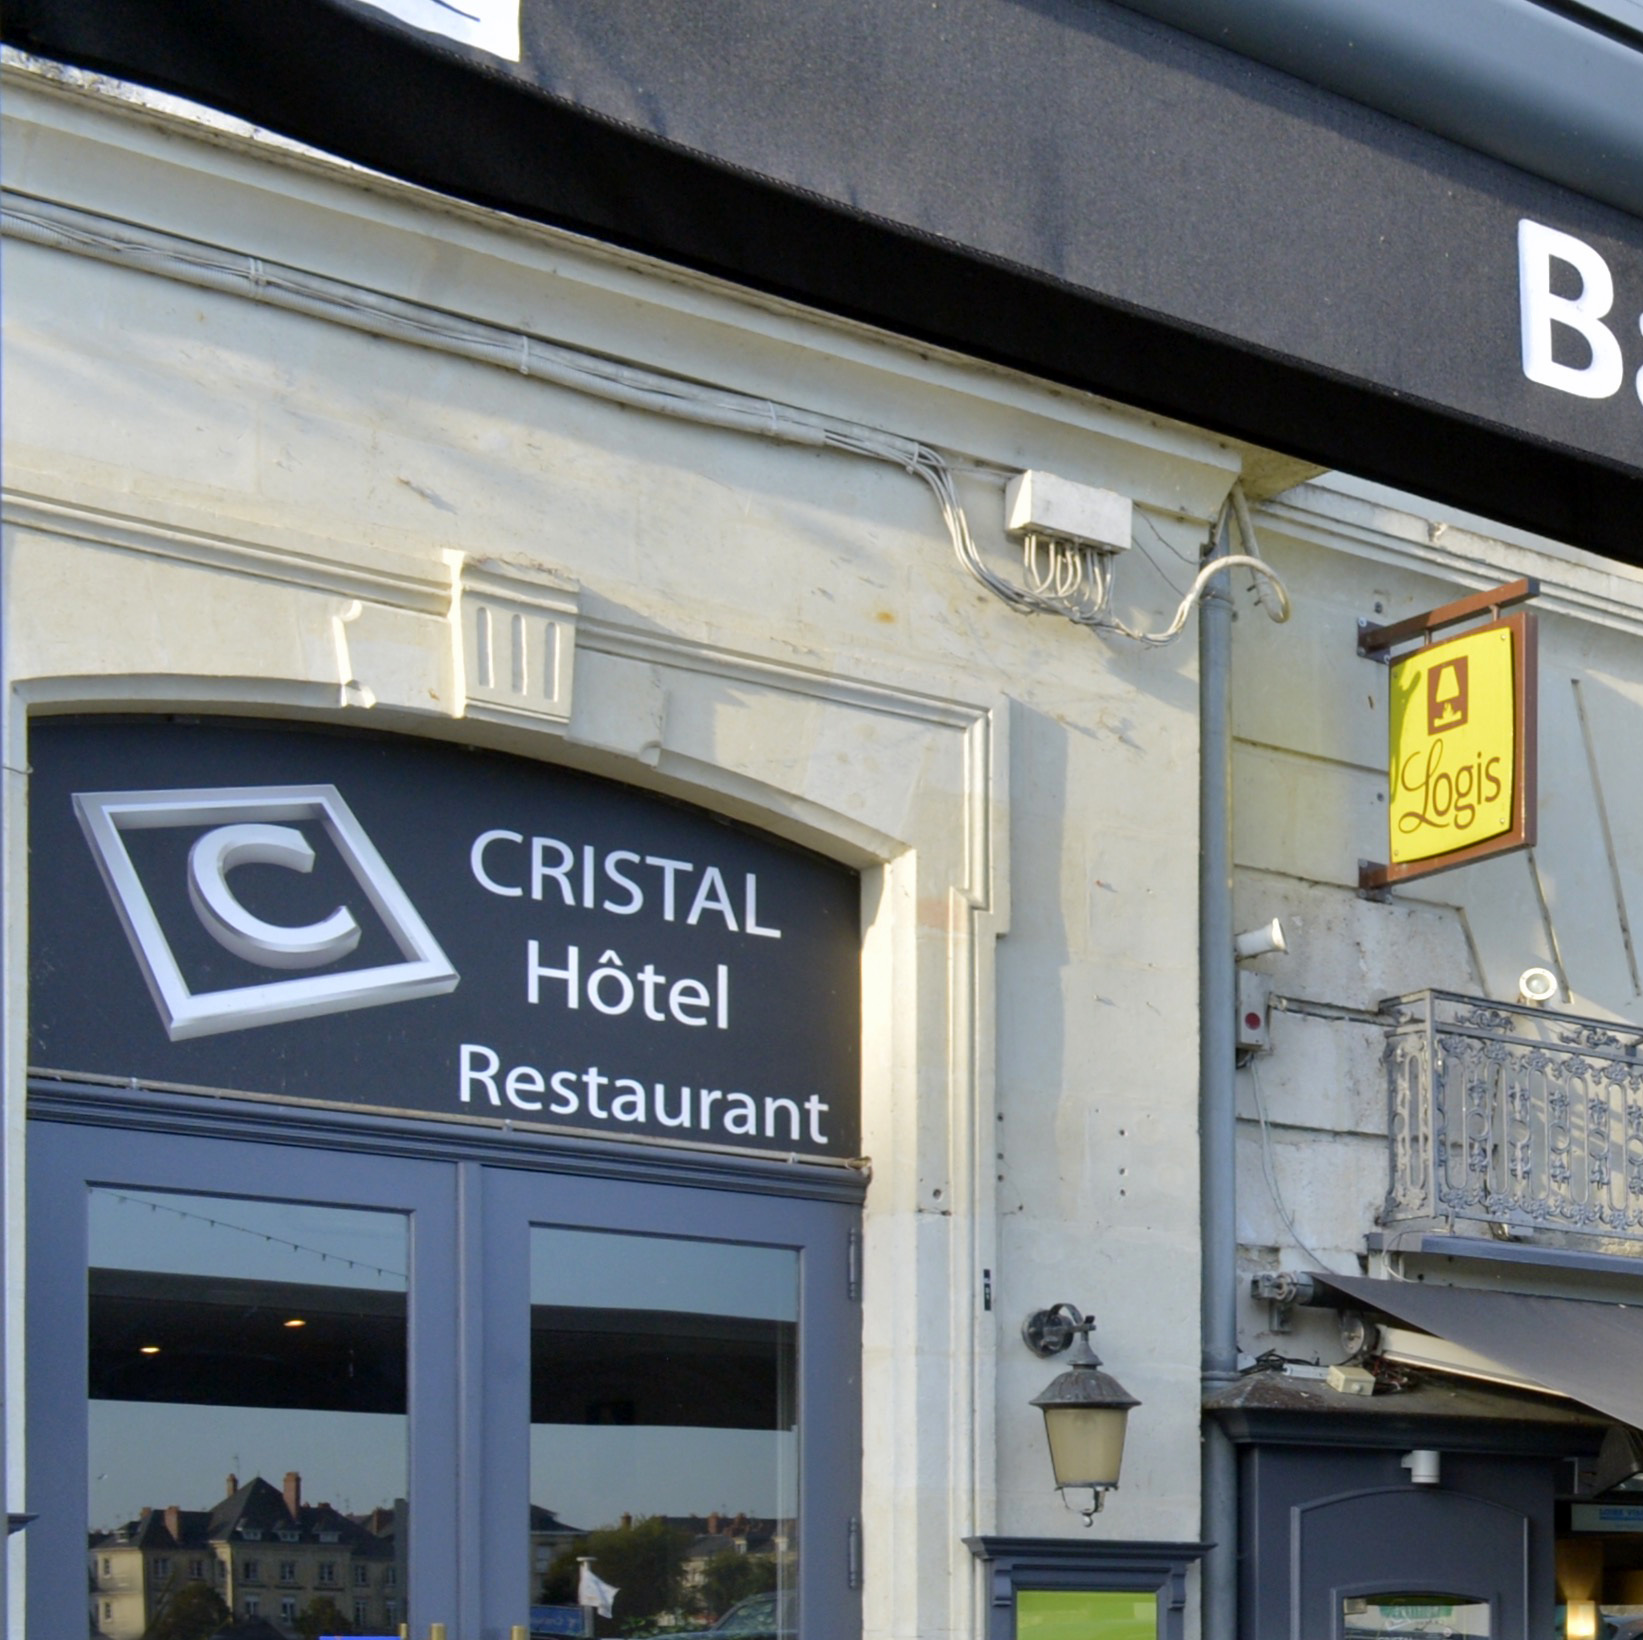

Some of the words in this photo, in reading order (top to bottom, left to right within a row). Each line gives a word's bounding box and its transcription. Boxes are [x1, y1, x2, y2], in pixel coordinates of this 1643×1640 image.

[1398, 738, 1502, 834] Logis
[469, 829, 782, 939] CRISTAL
[527, 939, 730, 1030] Hôtel
[458, 1043, 829, 1144] Restaurant
